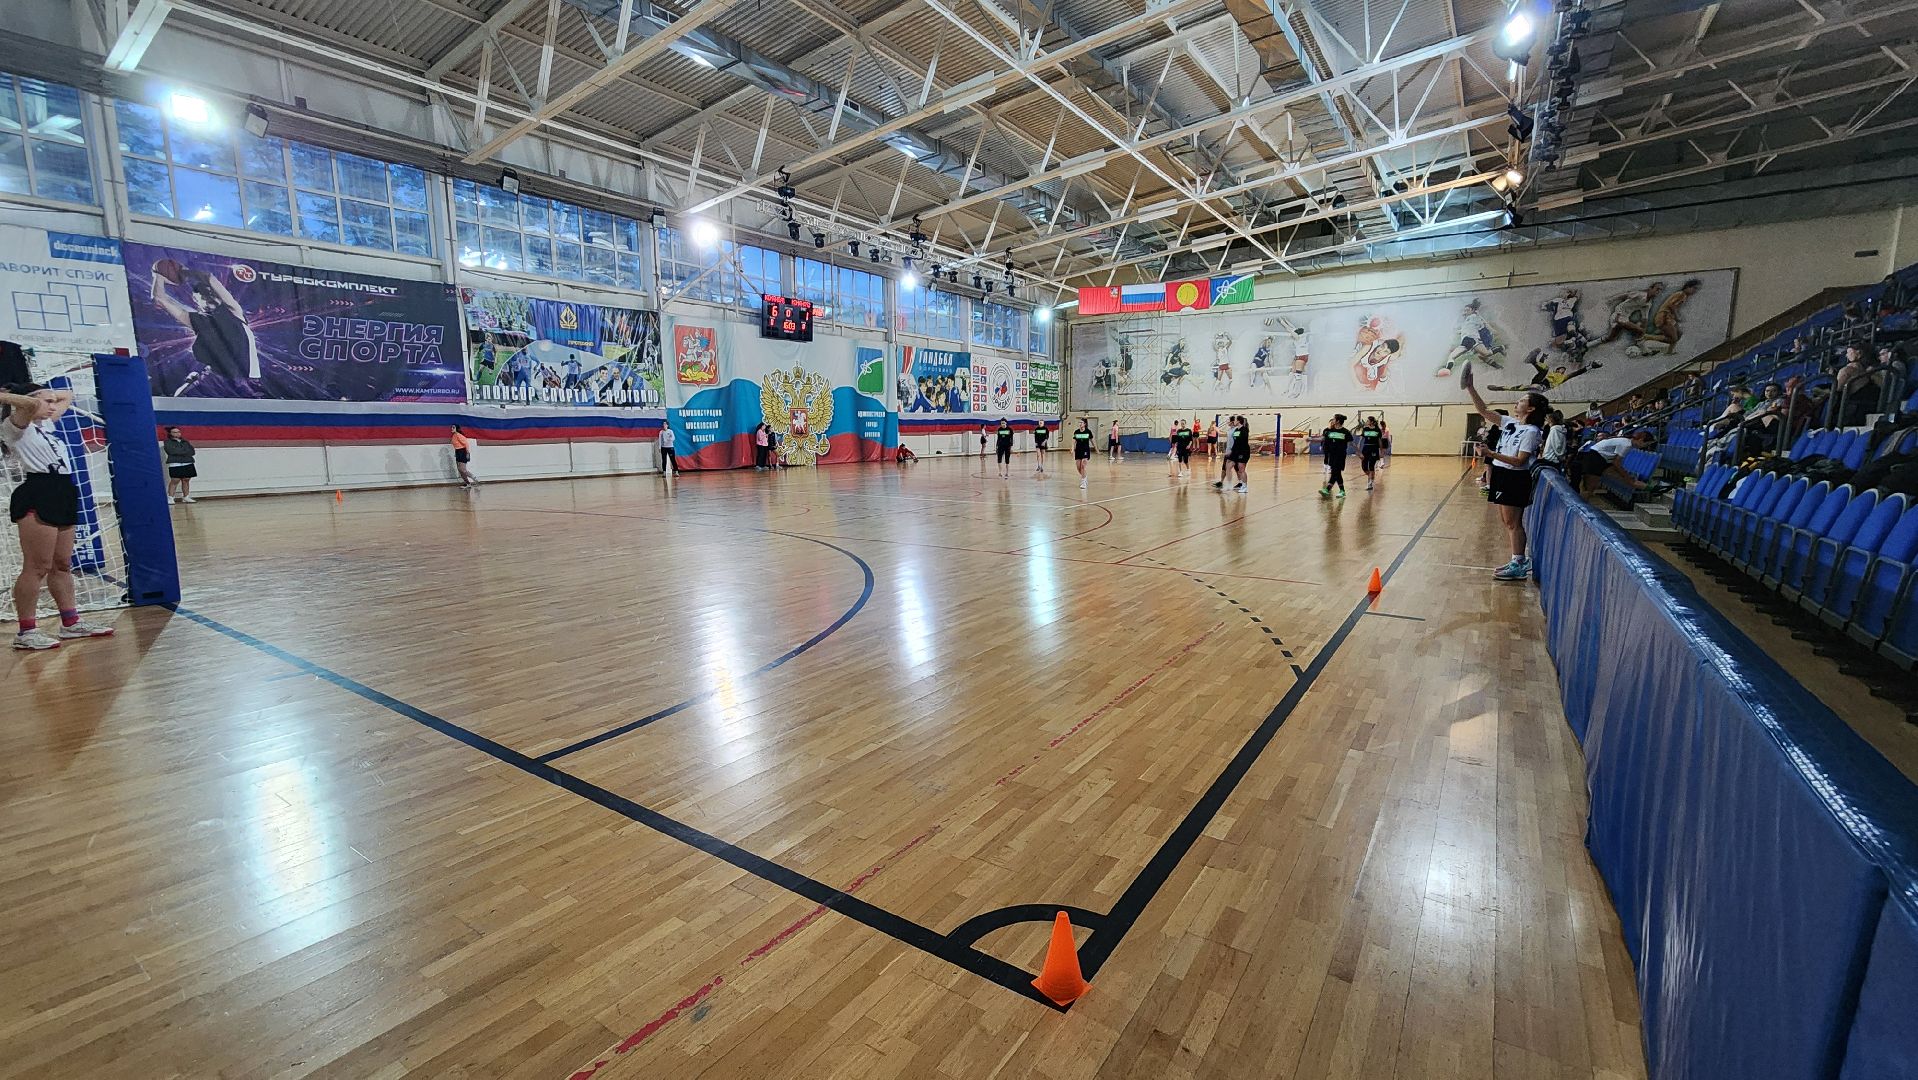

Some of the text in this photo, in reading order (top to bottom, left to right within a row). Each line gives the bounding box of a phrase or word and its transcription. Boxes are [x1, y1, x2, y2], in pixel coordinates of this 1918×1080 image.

[65, 268, 115, 282] СПЭЙС
[258, 271, 398, 295] ТУРБОКОМПЛЕКТ
[771, 305, 779, 318] 6
[785, 309, 791, 318] 0
[303, 314, 444, 345] ЭНЕРГИЯ
[299, 337, 443, 365] СПОРТА
[918, 350, 954, 367] ГАНДБОЛ
[394, 387, 460, 395] WWW.KAMTURBO.RU
[474, 384, 536, 402] СПОНСОР
[542, 387, 588, 403] СПОРТА
[606, 388, 660, 404] ПРОТВИНО
